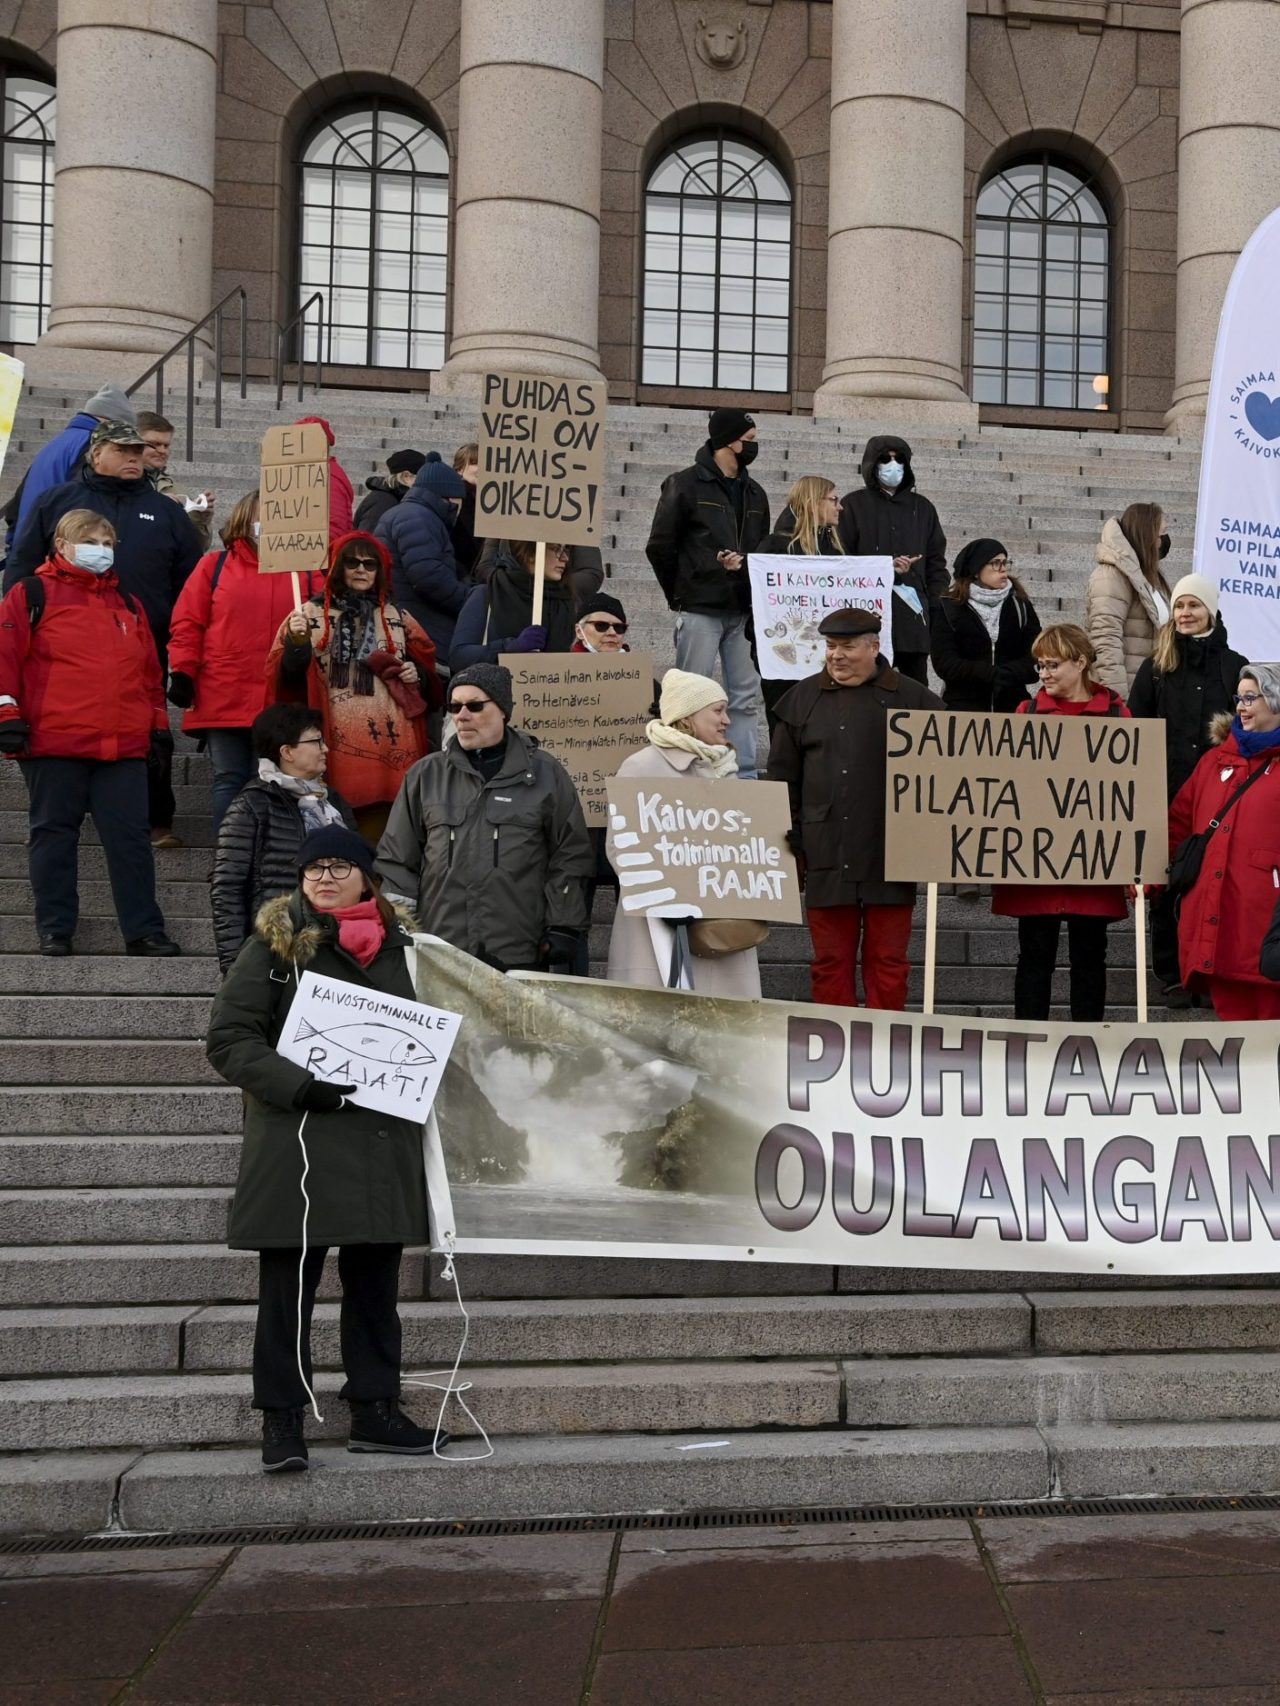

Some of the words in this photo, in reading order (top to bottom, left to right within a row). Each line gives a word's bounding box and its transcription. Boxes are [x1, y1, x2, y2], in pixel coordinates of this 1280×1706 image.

[484, 374, 595, 416] PUHDAS
[1230, 371, 1275, 404] SAIMAA
[281, 432, 304, 456] EI
[482, 412, 537, 440] VESI
[553, 420, 599, 450] ON
[264, 464, 325, 493] UUTTA
[485, 446, 587, 480] IHMIS-
[264, 495, 320, 521] TALVI-
[480, 481, 598, 533] OIKEUS!
[267, 533, 325, 552] VAARAA
[1215, 537, 1242, 553] VOI
[766, 572, 782, 587] EI
[1238, 559, 1277, 579] VAIN
[768, 593, 817, 607] SUOMEN
[516, 670, 560, 684] Saimaa
[888, 711, 1064, 761] SAIMAAN
[1085, 724, 1140, 766] VOI
[893, 773, 1021, 821] PILATA
[1046, 777, 1135, 822] VAIN
[654, 835, 781, 867] toiminnalle
[698, 865, 788, 900] RAJAT
[311, 984, 450, 1031] KAIVOSTOIMINNALLE
[787, 1015, 1245, 1117] PUHTAAN
